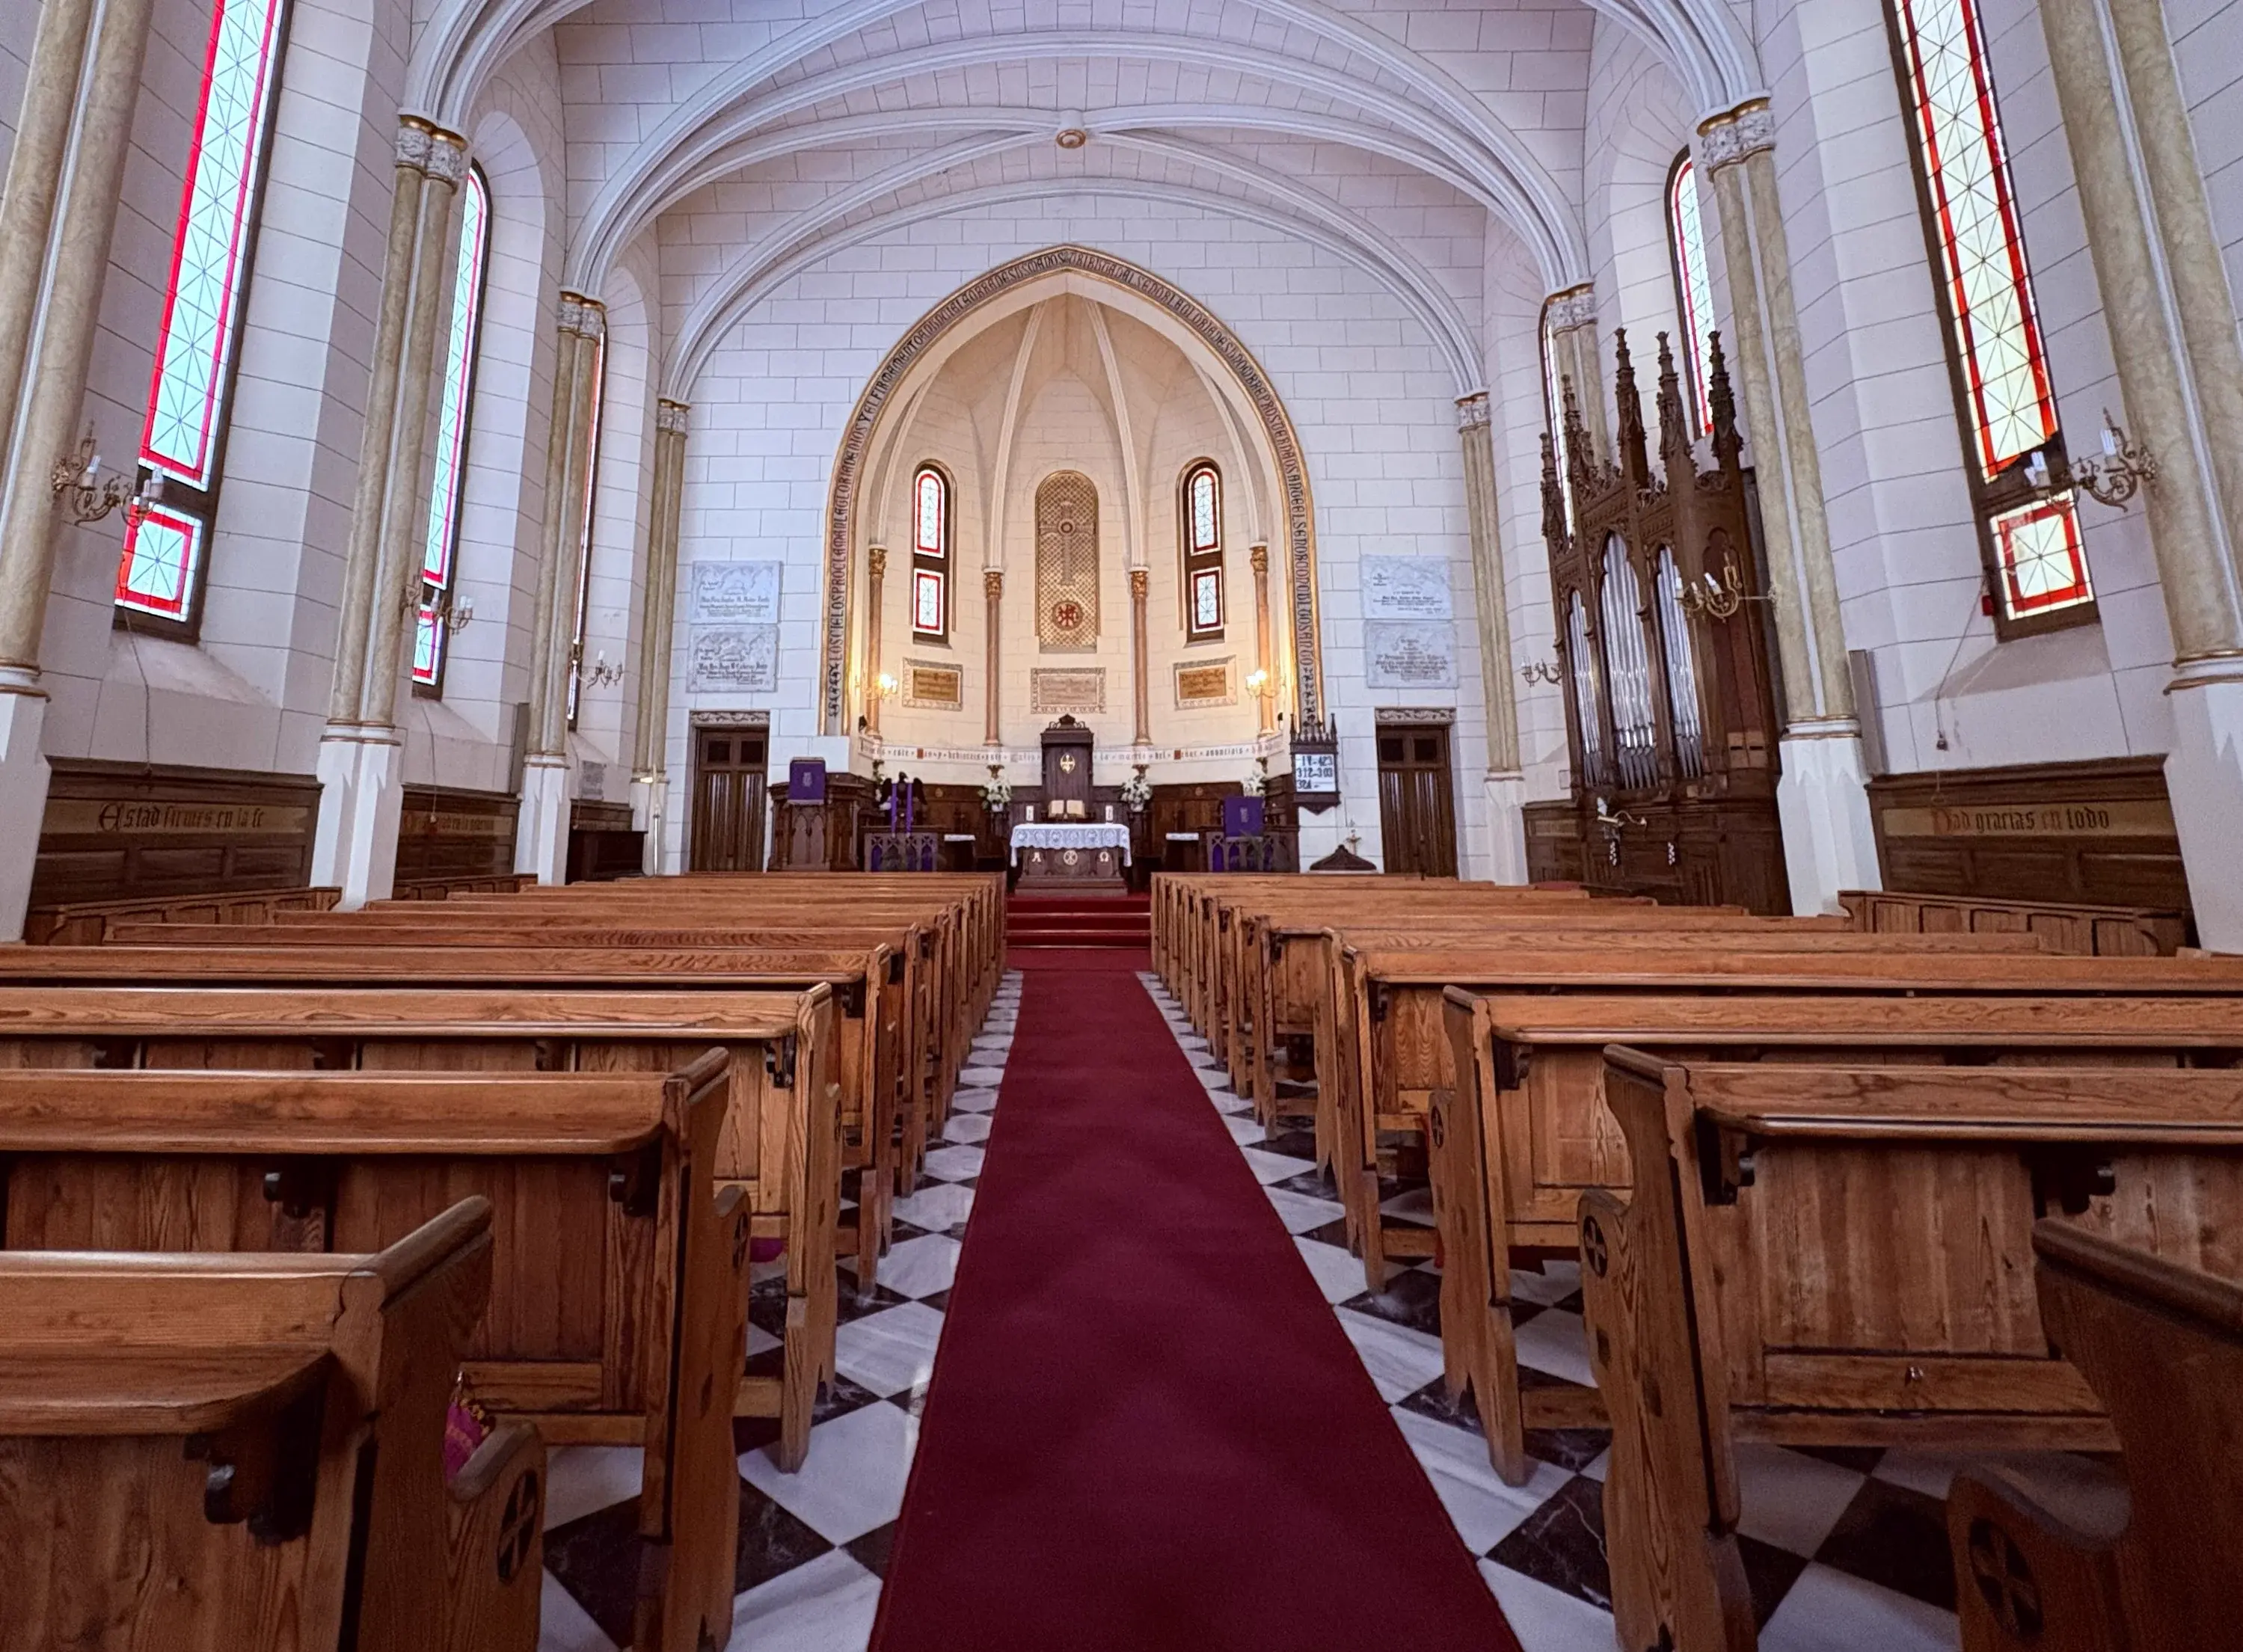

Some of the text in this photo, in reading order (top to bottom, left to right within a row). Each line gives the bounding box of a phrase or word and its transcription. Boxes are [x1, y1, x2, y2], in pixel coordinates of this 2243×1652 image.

[994, 271, 1010, 286] DE
[1120, 268, 1135, 283] AL
[954, 292, 972, 309] LA
[1166, 292, 1185, 310] LA
[1212, 330, 1228, 347] DE
[1221, 340, 1239, 358] SU
[870, 334, 924, 401] FIRMAMENTO
[1231, 352, 1267, 397] NOMBRE
[862, 396, 880, 414] EL
[858, 411, 872, 425] Y
[847, 423, 867, 451] DIOS
[1257, 392, 1298, 474] PROSTERNAOS
[843, 449, 858, 466] DE
[1286, 473, 1304, 506] ANTE
[834, 507, 847, 522] LA
[1291, 505, 1306, 521] EL
[832, 522, 846, 593] PROCLAMAN
[831, 594, 844, 636] CIELOS
[829, 637, 842, 660] LOS
[1298, 624, 1313, 666] SANTO
